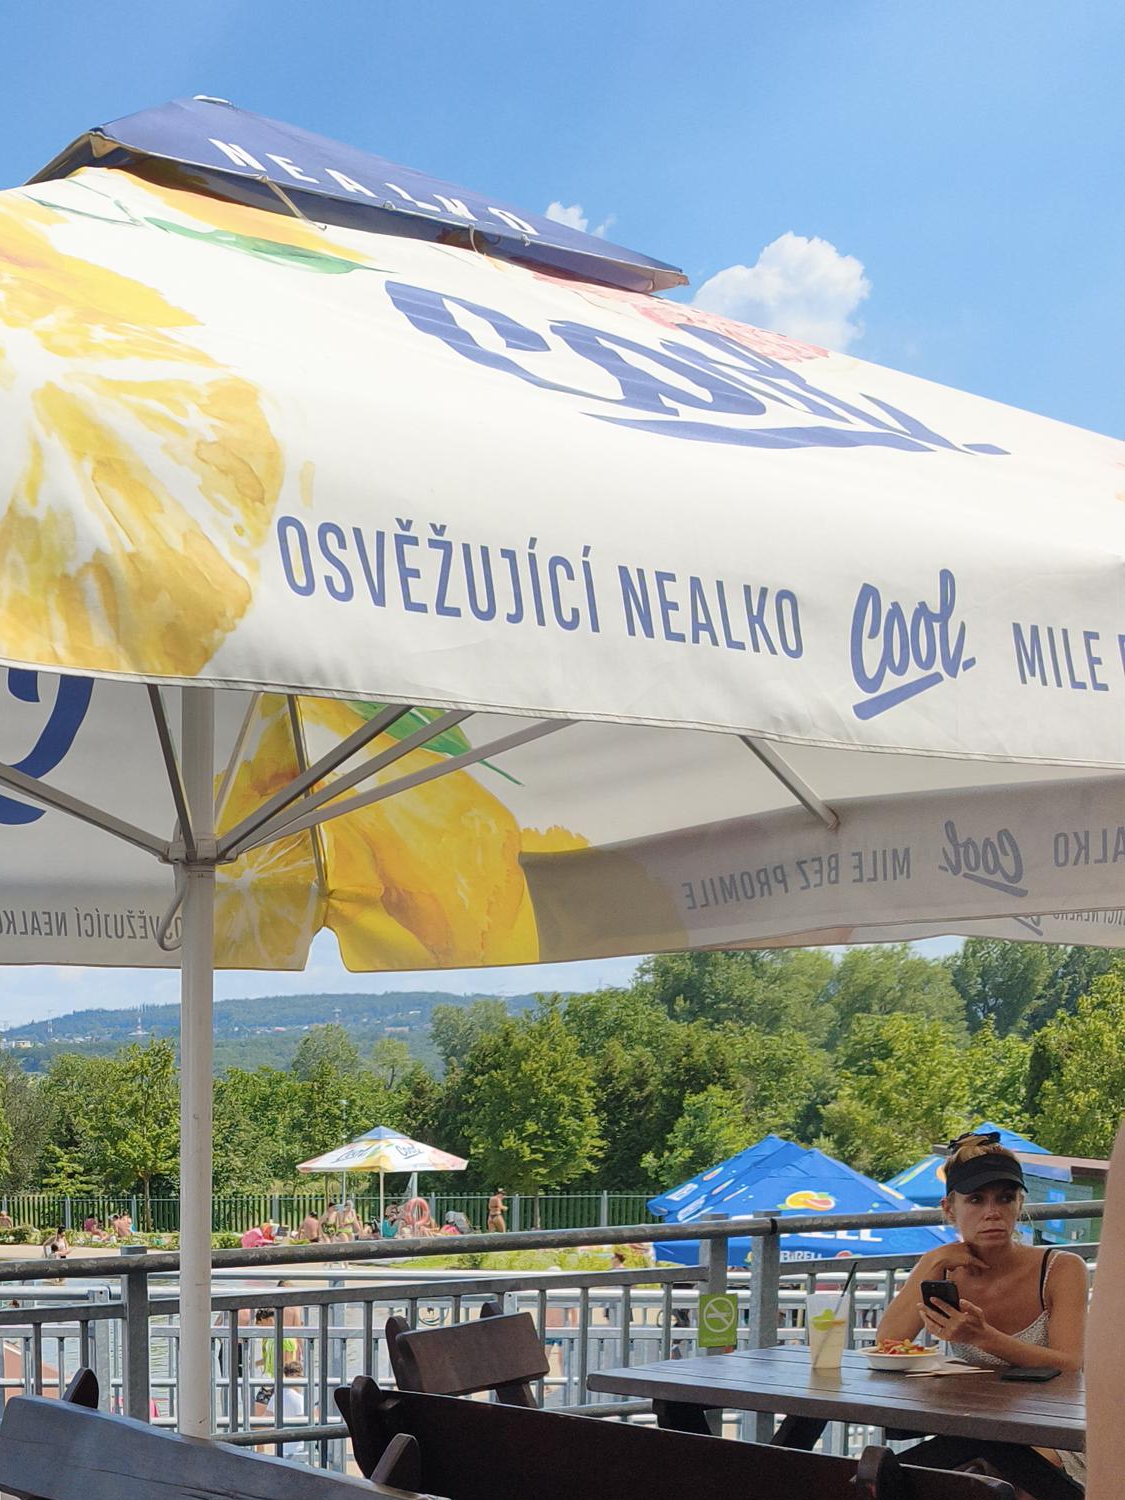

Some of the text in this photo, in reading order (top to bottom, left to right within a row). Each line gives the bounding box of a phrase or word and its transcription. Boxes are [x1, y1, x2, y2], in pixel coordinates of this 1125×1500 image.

[276, 515, 600, 634] OSVĚŽUJÍCÍ
[617, 565, 804, 660] NEALKO
[849, 568, 976, 722] Cool
[1011, 621, 1109, 692] MILE
